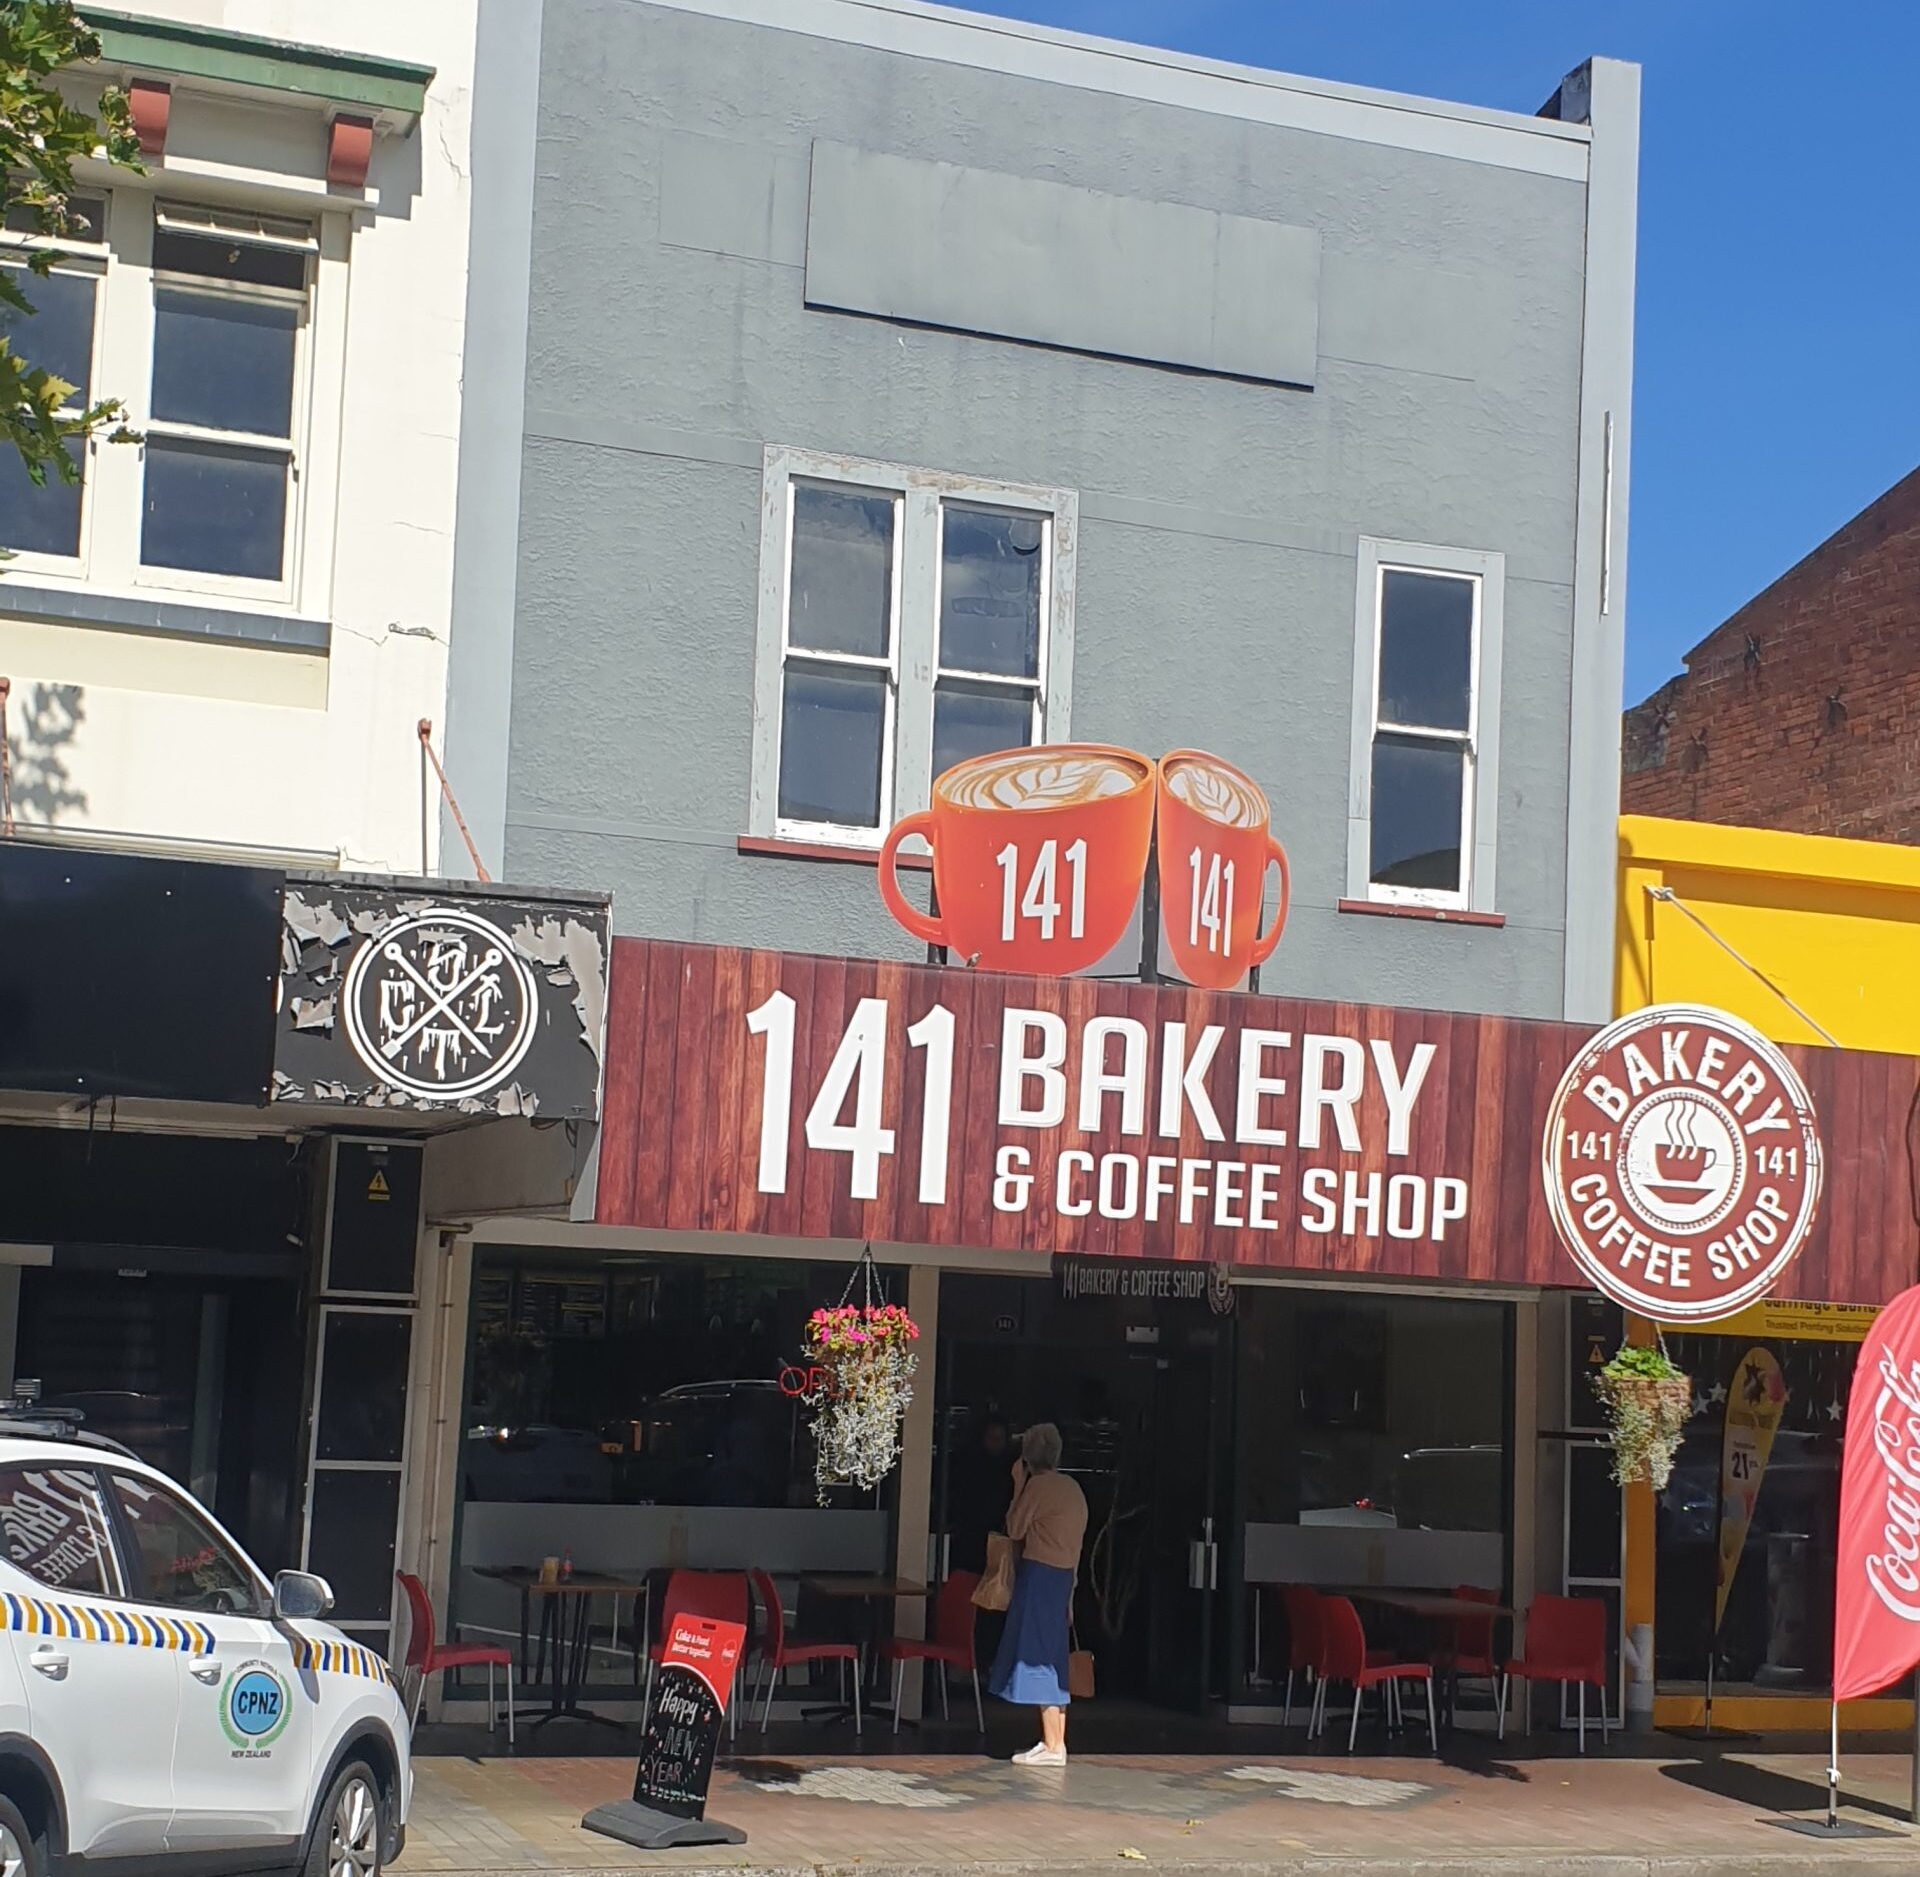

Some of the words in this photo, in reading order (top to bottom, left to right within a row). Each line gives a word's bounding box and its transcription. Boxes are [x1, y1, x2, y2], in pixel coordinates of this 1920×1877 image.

[996, 838, 1087, 941] 141
[1189, 845, 1235, 957] 141
[746, 989, 956, 1205] 141
[998, 1007, 1438, 1155] BAKERY
[1583, 1030, 1791, 1136] BAKERY
[1567, 1131, 1612, 1161] 141
[1755, 1145, 1797, 1177] 141
[992, 1145, 1035, 1213] &
[1056, 1150, 1282, 1230] COFFEE
[1300, 1167, 1468, 1241] SHOP
[1570, 1173, 1691, 1288] COFFEE
[1707, 1186, 1789, 1281] SHOP
[1063, 1262, 1079, 1299] 141
[1079, 1268, 1120, 1295] BAKERY
[1121, 1269, 1129, 1296] &
[1131, 1270, 1171, 1297] COFFEE
[1173, 1271, 1205, 1299] SHOP
[238, 1691, 278, 1714] CPNZ
[658, 1686, 699, 1725] Happy
[663, 1726, 699, 1761] NEW
[650, 1755, 683, 1785] YEAR
